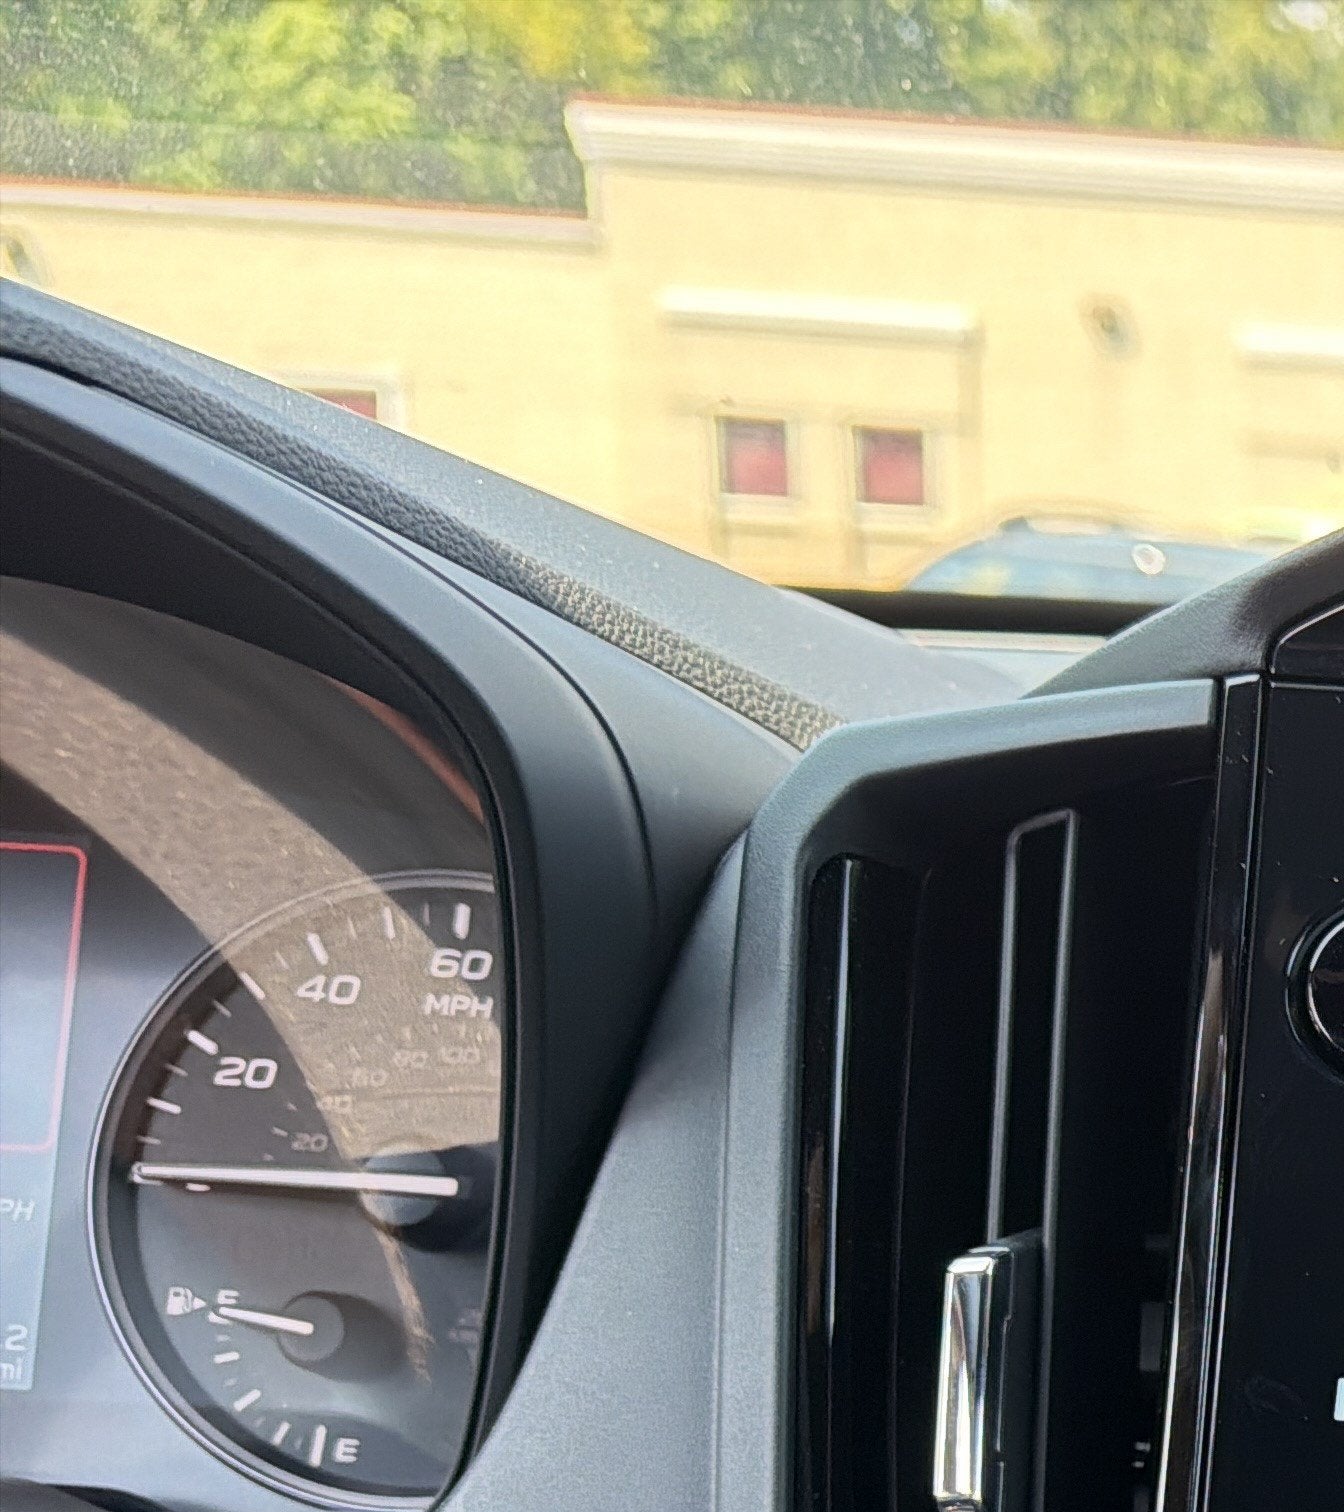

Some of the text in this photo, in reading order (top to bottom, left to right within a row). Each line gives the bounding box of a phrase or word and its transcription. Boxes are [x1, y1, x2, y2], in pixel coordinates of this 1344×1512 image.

[429, 948, 494, 982] 60
[296, 973, 362, 1006] 40
[421, 991, 494, 1021] MPH
[213, 1057, 279, 1090] 20
[335, 1437, 361, 1463] E
